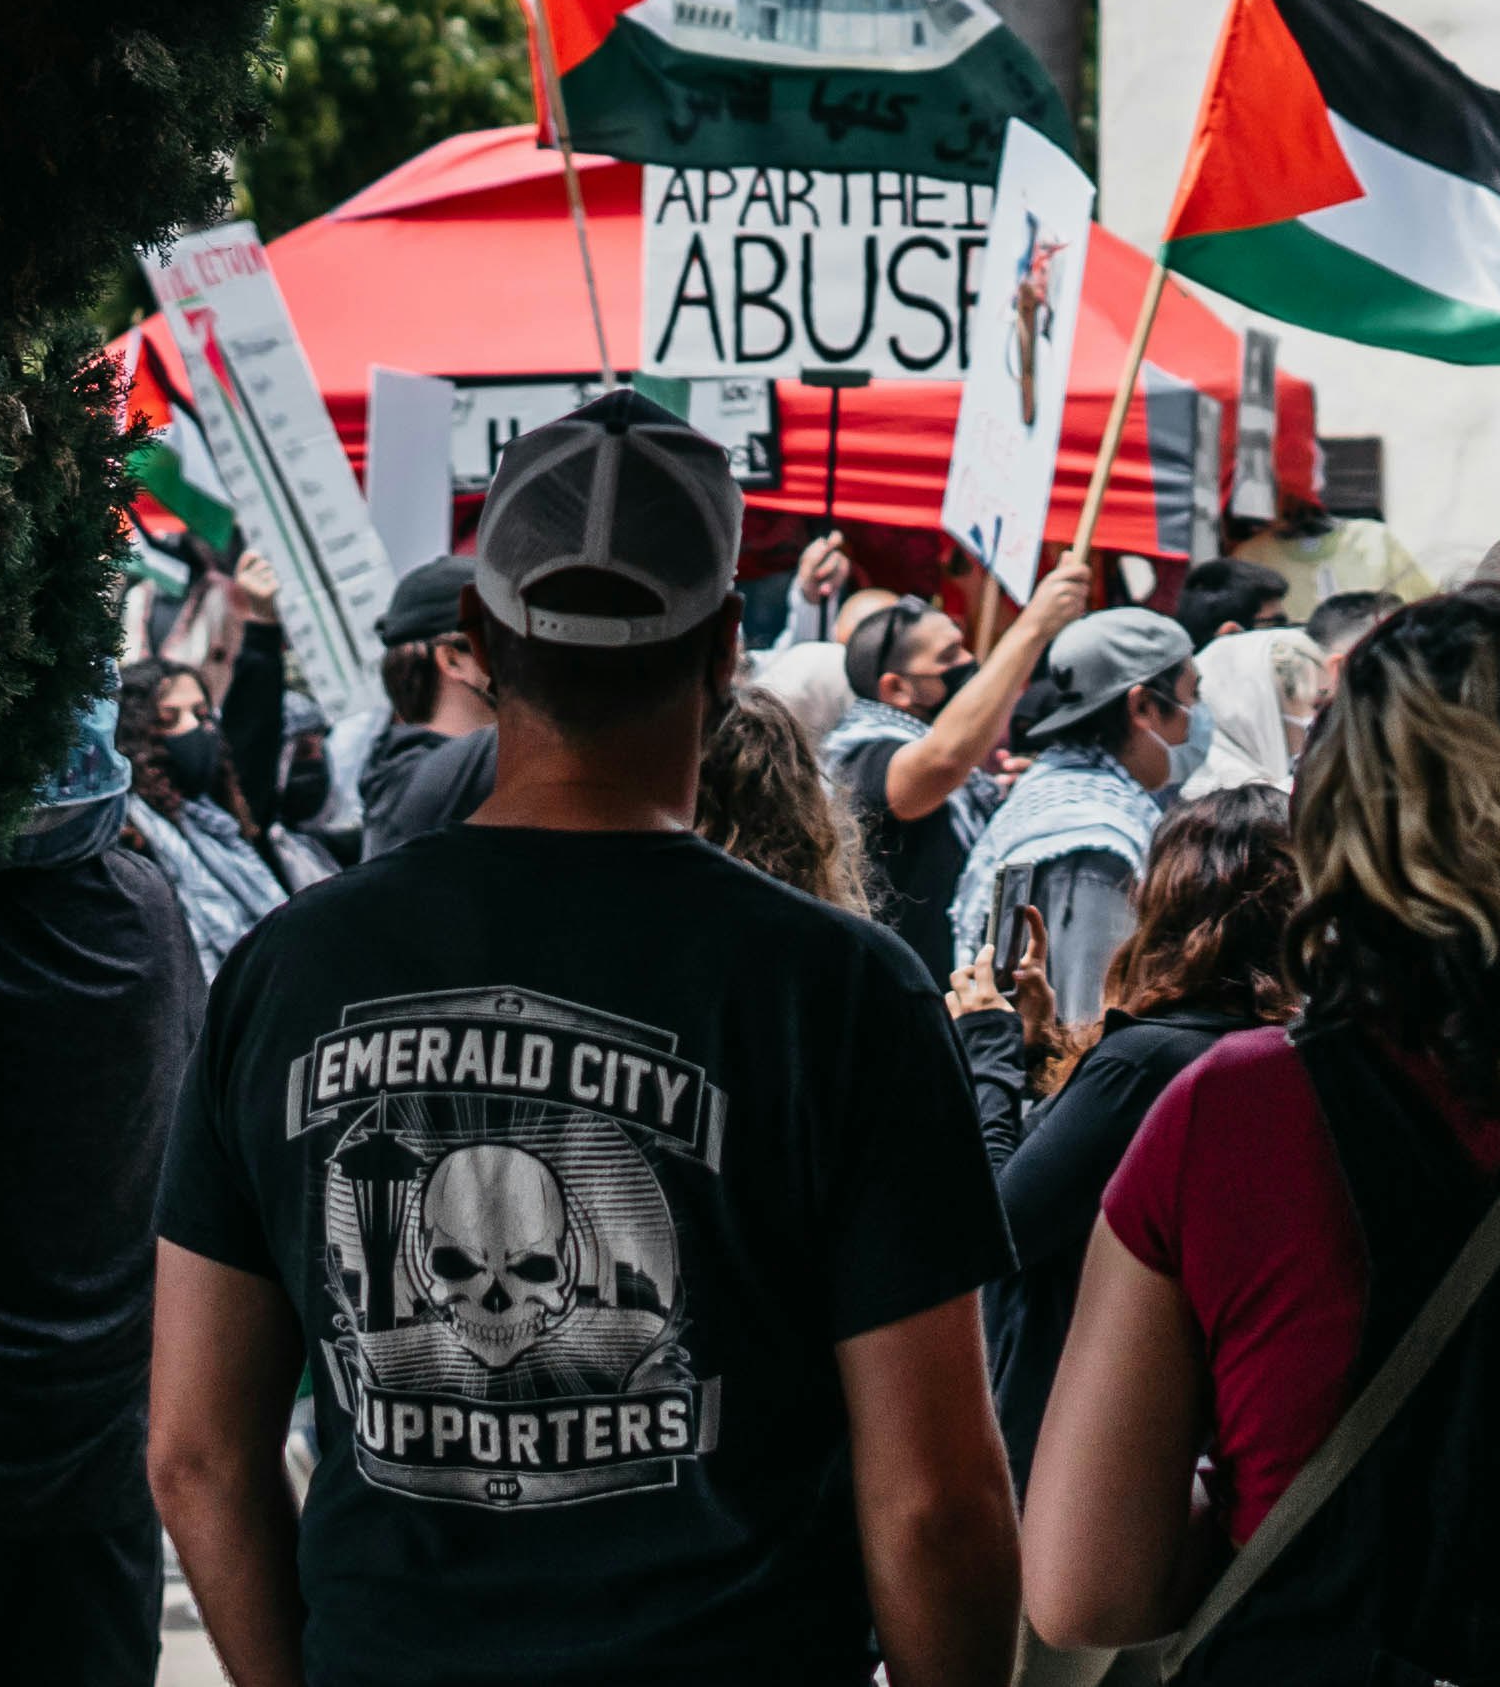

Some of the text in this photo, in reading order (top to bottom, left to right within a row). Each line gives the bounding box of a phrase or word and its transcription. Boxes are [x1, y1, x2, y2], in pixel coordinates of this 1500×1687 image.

[316, 1027, 690, 1126] EMERALD CITY
[357, 1397, 690, 1465] UPPORTERS
